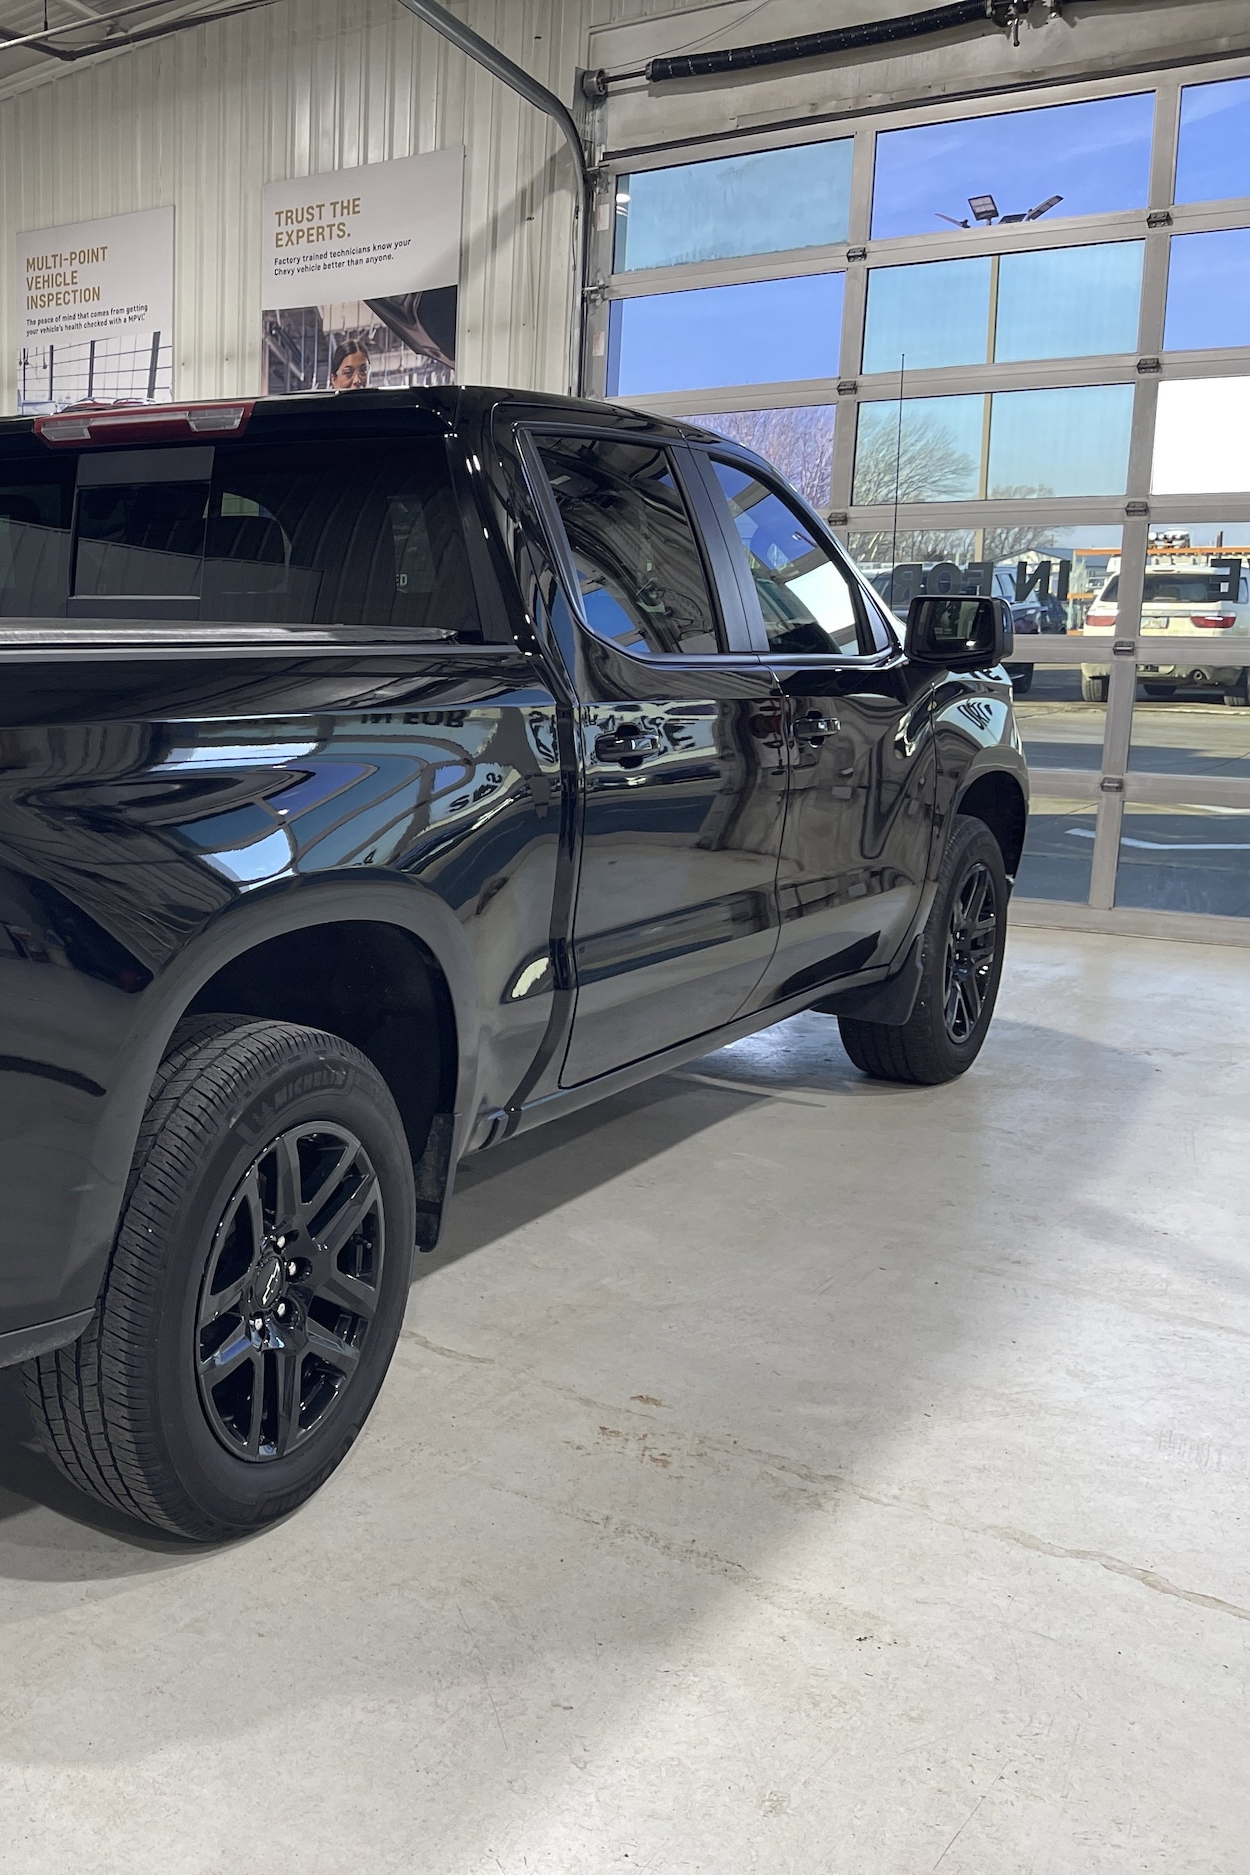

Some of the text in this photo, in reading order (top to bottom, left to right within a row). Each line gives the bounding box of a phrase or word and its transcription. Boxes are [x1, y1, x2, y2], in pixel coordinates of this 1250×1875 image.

[275, 198, 361, 227] TRUST THE
[275, 222, 351, 248] EXPERTS.
[26, 246, 108, 273] MULTI-POINT
[275, 239, 412, 266] Factory trained technicians know your
[275, 254, 394, 276] Chevy vehicle better than anyone.
[26, 270, 78, 291] VEHICLE
[27, 286, 101, 310] INSPECTION
[26, 328, 39, 337] your
[40, 324, 64, 335] vehicle's
[65, 322, 83, 331] health
[84, 318, 108, 329] checked
[109, 317, 122, 325] with
[38, 317, 54, 327] peace
[55, 315, 61, 324] of
[62, 314, 76, 322] mind
[78, 312, 89, 320] that
[110, 308, 125, 316] from
[126, 304, 148, 315] getting
[274, 1070, 347, 1108] MICHELIN
